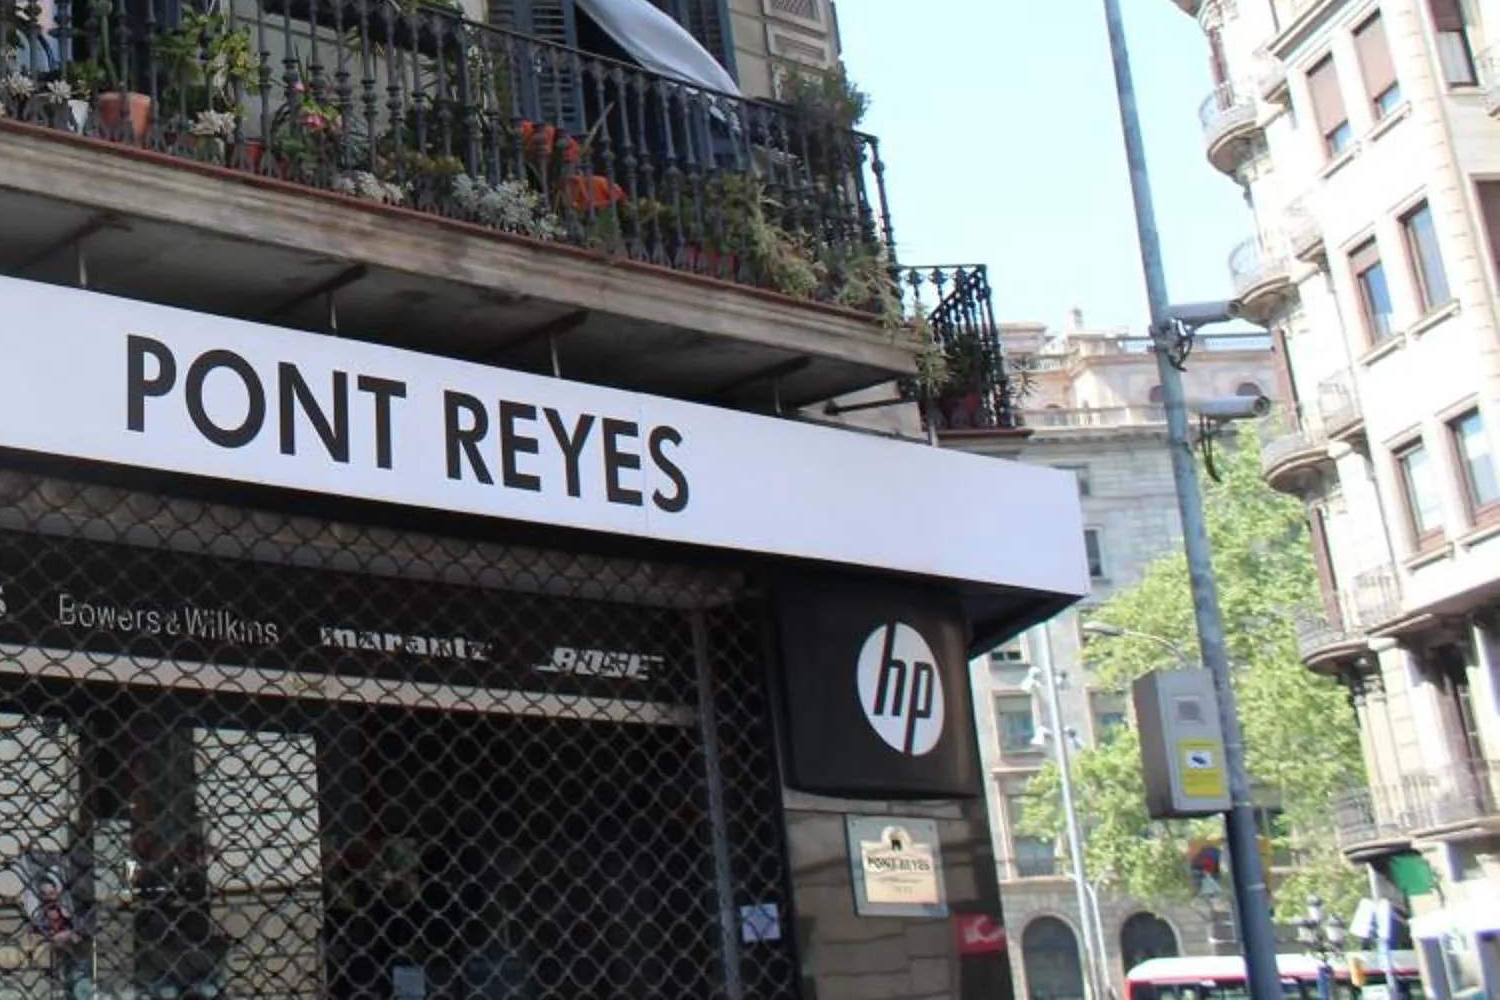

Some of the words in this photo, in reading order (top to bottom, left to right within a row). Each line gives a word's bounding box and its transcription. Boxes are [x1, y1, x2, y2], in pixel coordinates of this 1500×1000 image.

[126, 333, 407, 470] PONT
[443, 388, 690, 513] REYES
[318, 626, 495, 662] marantz
[533, 645, 665, 681] BOSE
[873, 621, 933, 755] hp
